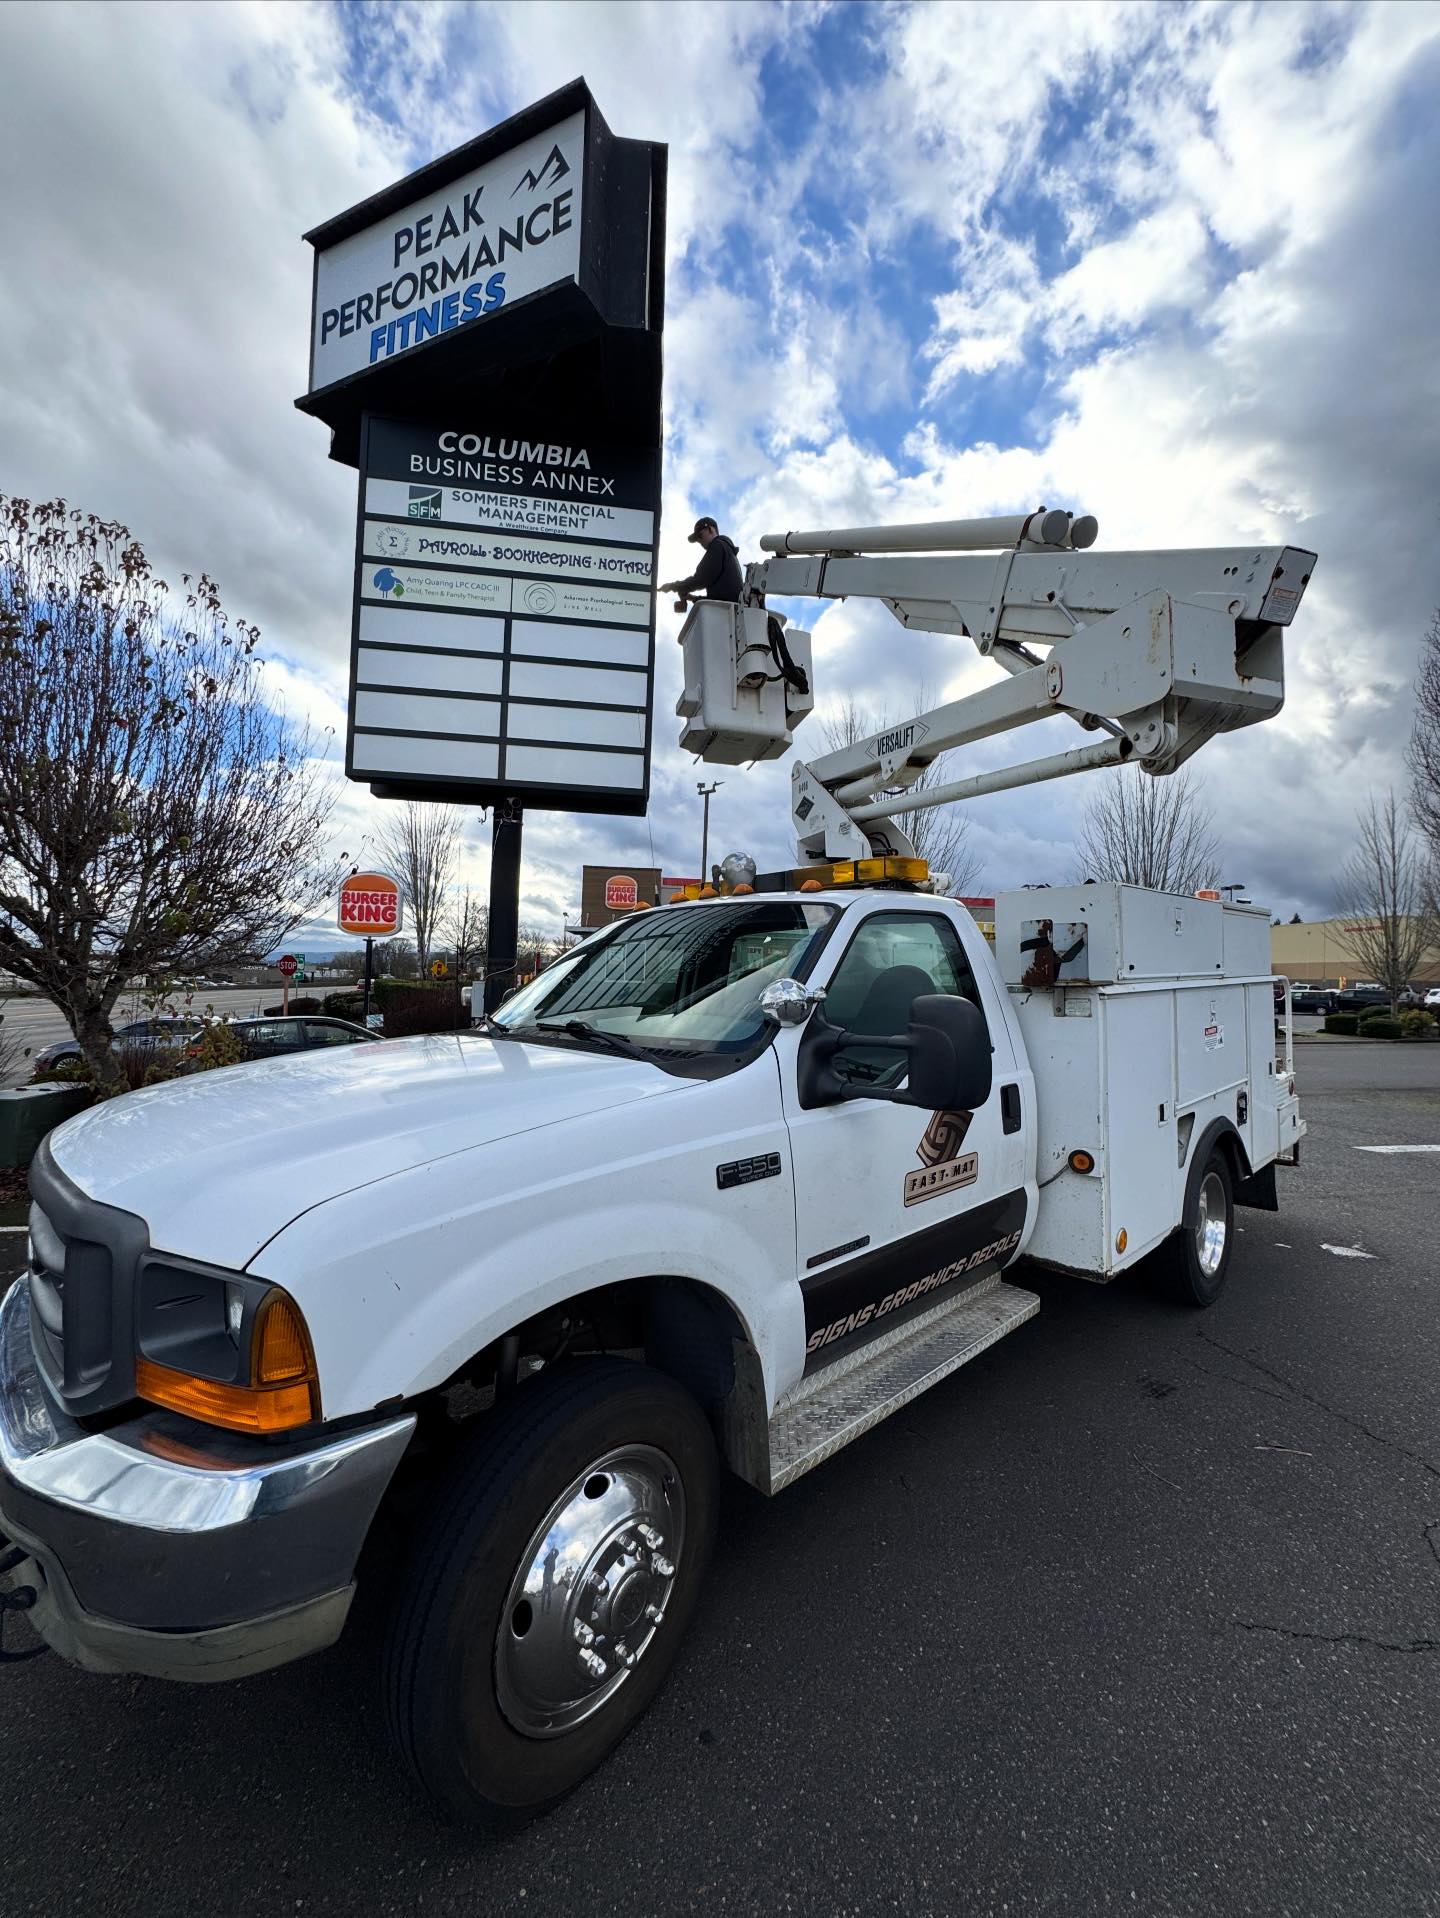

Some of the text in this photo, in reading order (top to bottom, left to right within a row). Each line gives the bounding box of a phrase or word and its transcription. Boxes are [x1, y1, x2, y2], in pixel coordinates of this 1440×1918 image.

[394, 185, 485, 269] PEAK
[321, 188, 573, 346] PERFORMANCE
[369, 272, 506, 364] FITNESS
[438, 431, 591, 470] COLUMBIA
[410, 454, 615, 496] BUSINESS ANNEX
[409, 505, 440, 518] SFM
[452, 490, 615, 519] SOMMERS FINANCIAL
[479, 507, 588, 529] MANAGEMENT
[540, 527, 568, 535] Company
[407, 576, 423, 585] Amy
[455, 581, 469, 589] LPC
[470, 582, 493, 591] CADC
[877, 725, 915, 756] VERSALIFT
[341, 891, 397, 906] BURGER
[608, 886, 635, 894] BURGER
[608, 893, 635, 902] KING
[341, 903, 397, 922] KING
[280, 961, 297, 970] STOP
[806, 1230, 1022, 1354] SIGNS GRAPHICS DECALS
